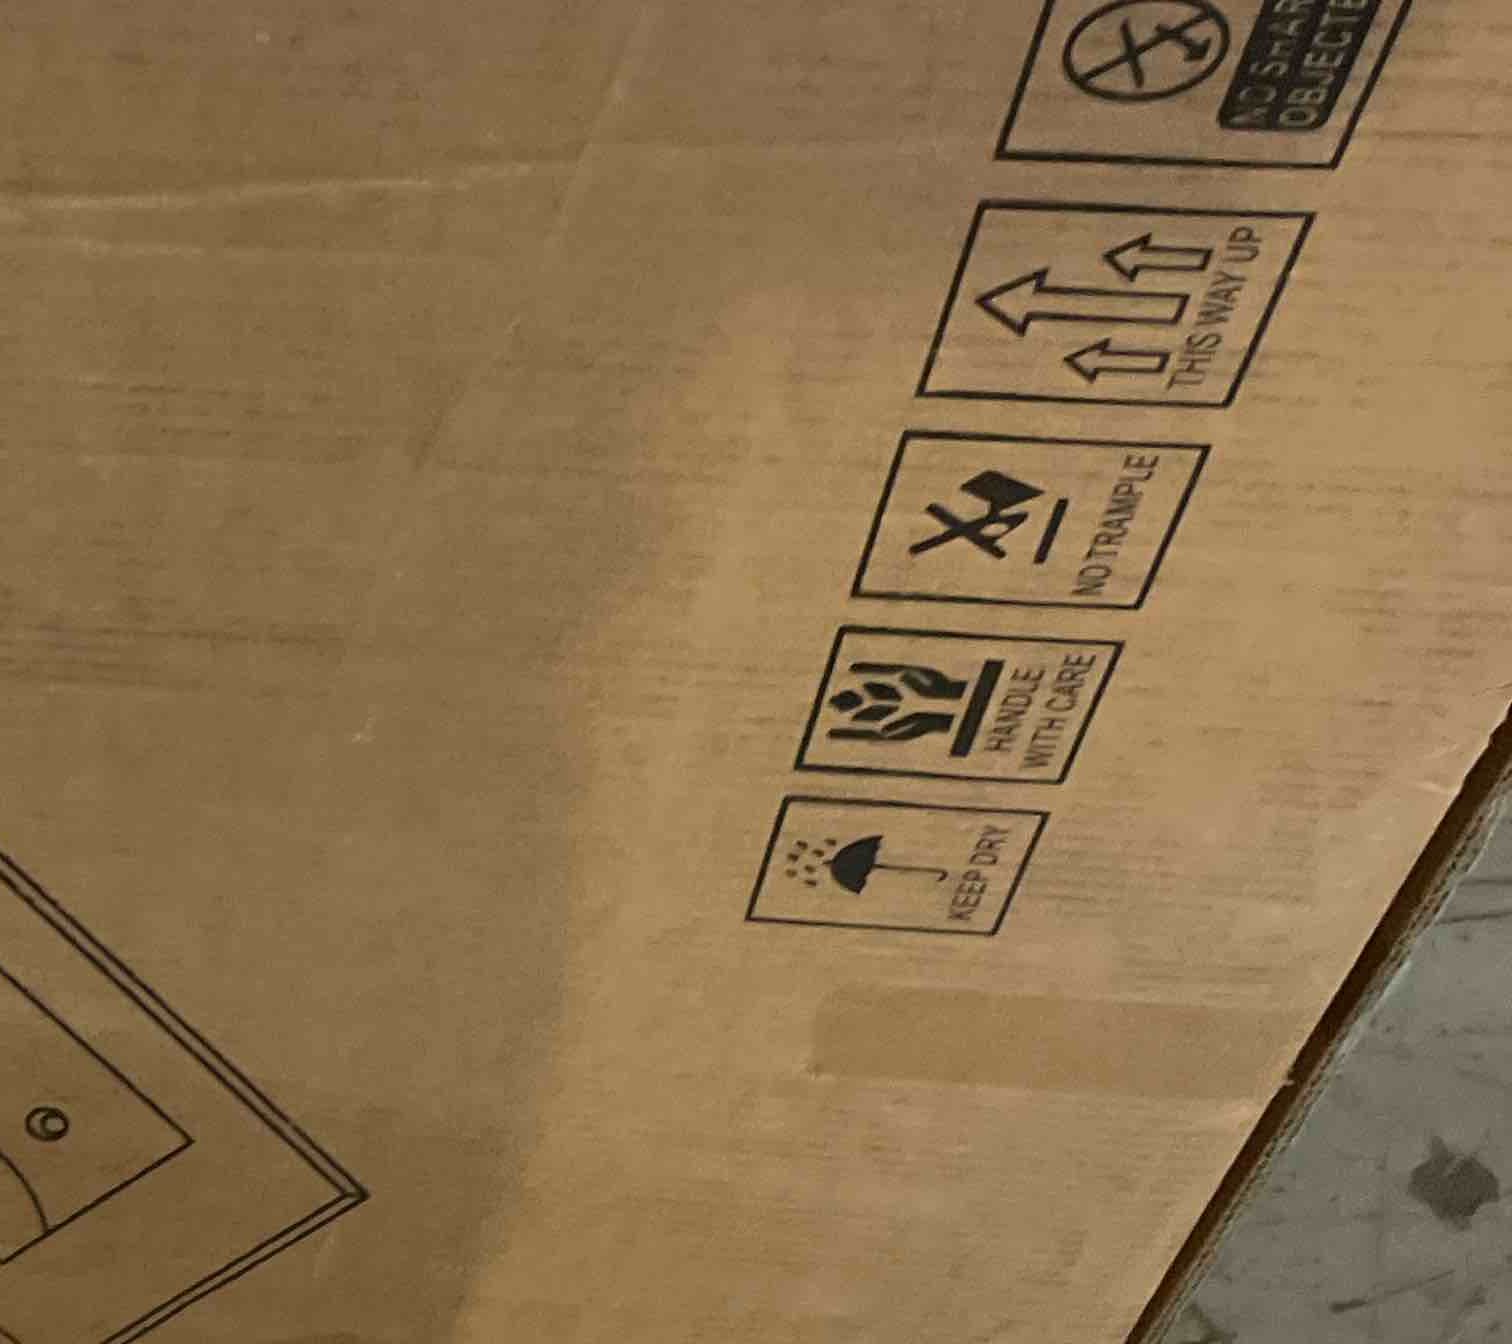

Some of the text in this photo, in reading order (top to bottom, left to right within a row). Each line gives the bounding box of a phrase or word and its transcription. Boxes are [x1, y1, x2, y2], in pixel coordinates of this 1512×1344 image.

[1165, 225, 1263, 391] THIS WAY UP
[1070, 454, 1161, 596] NO TRAMPLE
[984, 667, 1047, 752] HANDLE
[1021, 653, 1097, 770] WITH CARE
[947, 824, 1013, 922] KEEP DRY
